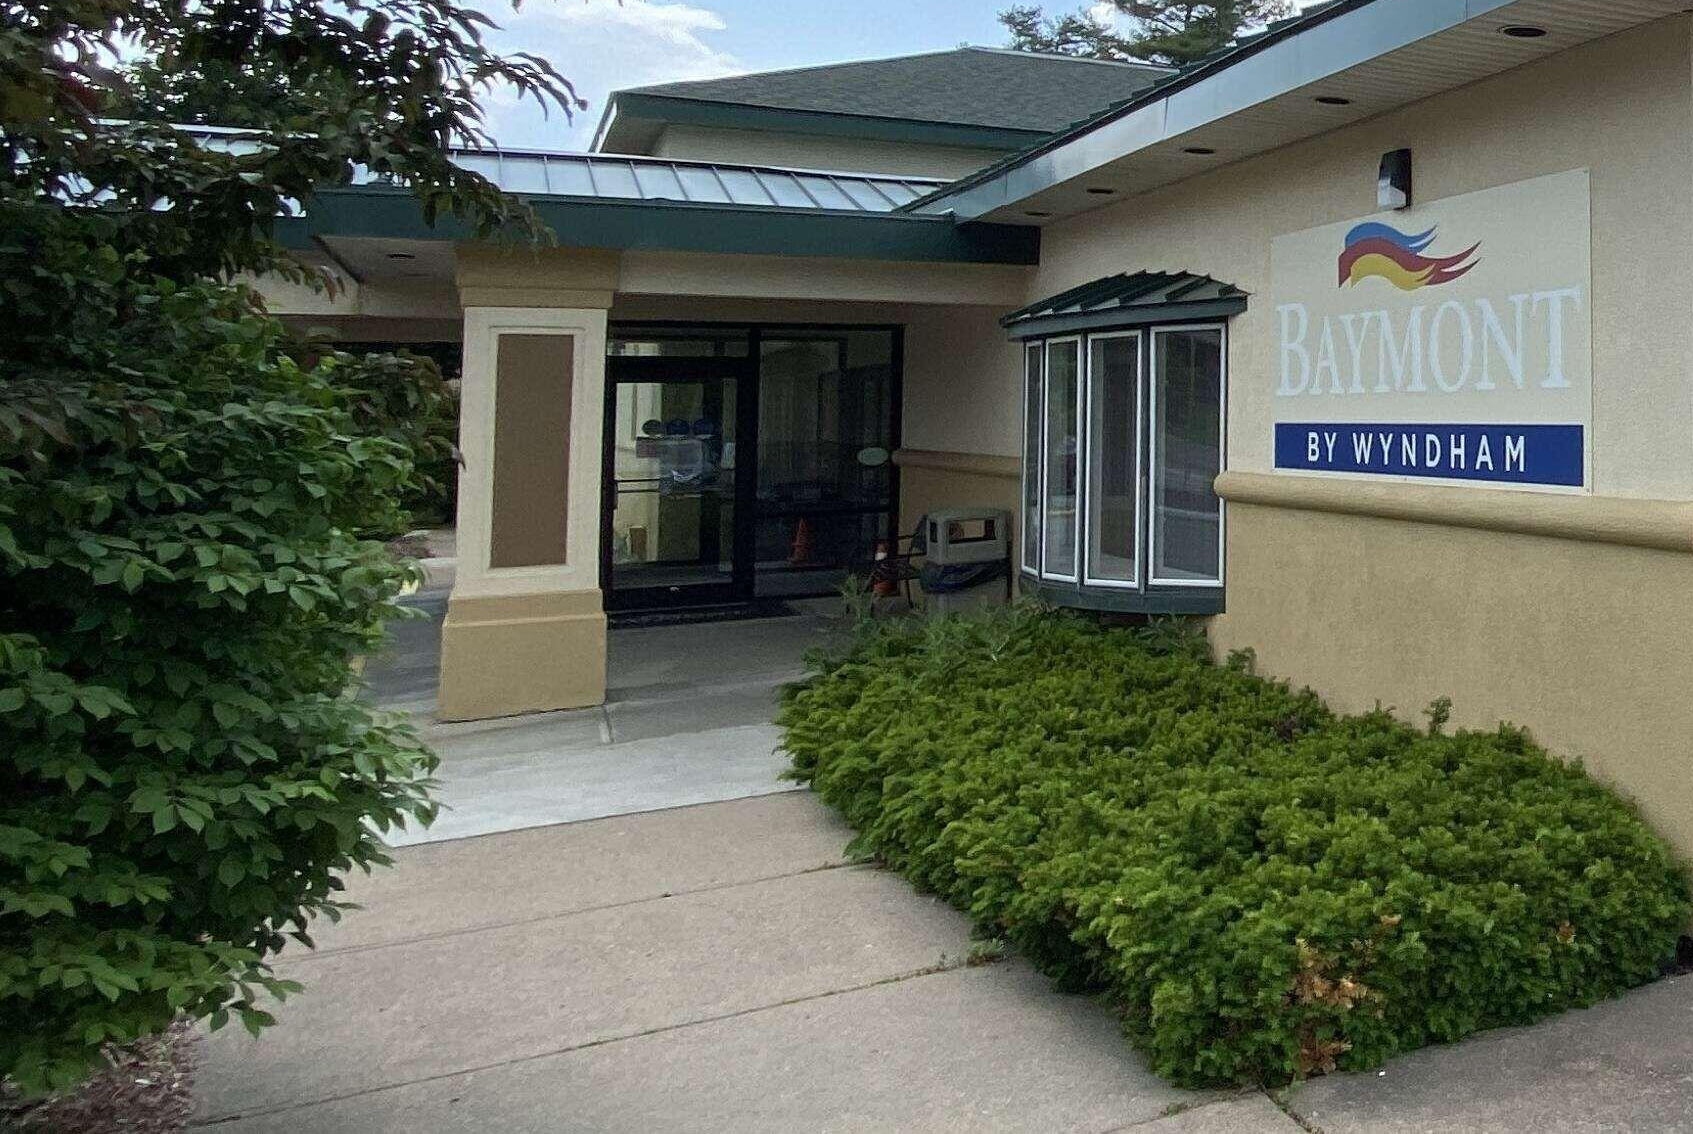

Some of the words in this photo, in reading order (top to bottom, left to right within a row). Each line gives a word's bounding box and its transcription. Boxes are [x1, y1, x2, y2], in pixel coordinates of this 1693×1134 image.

[1276, 287, 1581, 396] BAYMONT
[1307, 432, 1337, 463] BY
[1353, 433, 1526, 472] WYNDHAM
